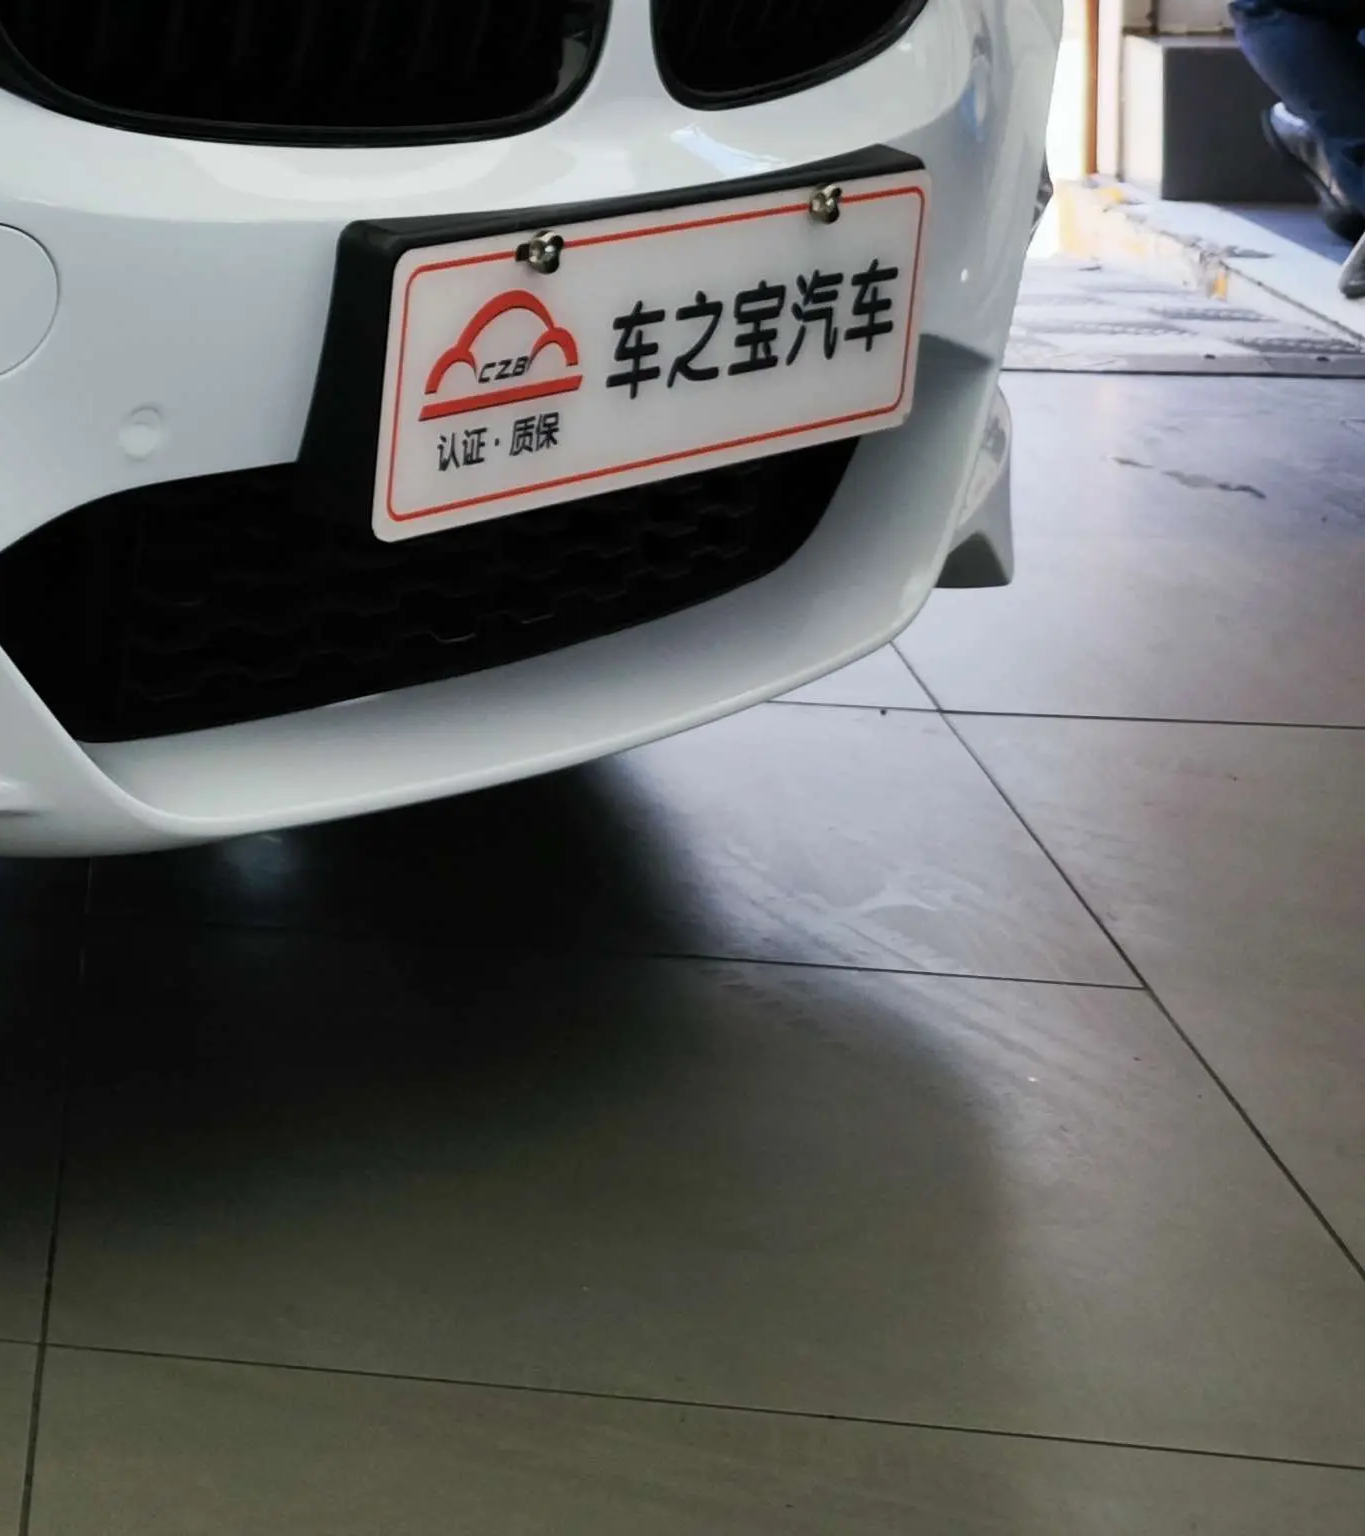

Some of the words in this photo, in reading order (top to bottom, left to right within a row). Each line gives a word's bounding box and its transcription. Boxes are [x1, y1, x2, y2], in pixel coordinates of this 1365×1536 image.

[605, 258, 900, 401] 车之宝汽车
